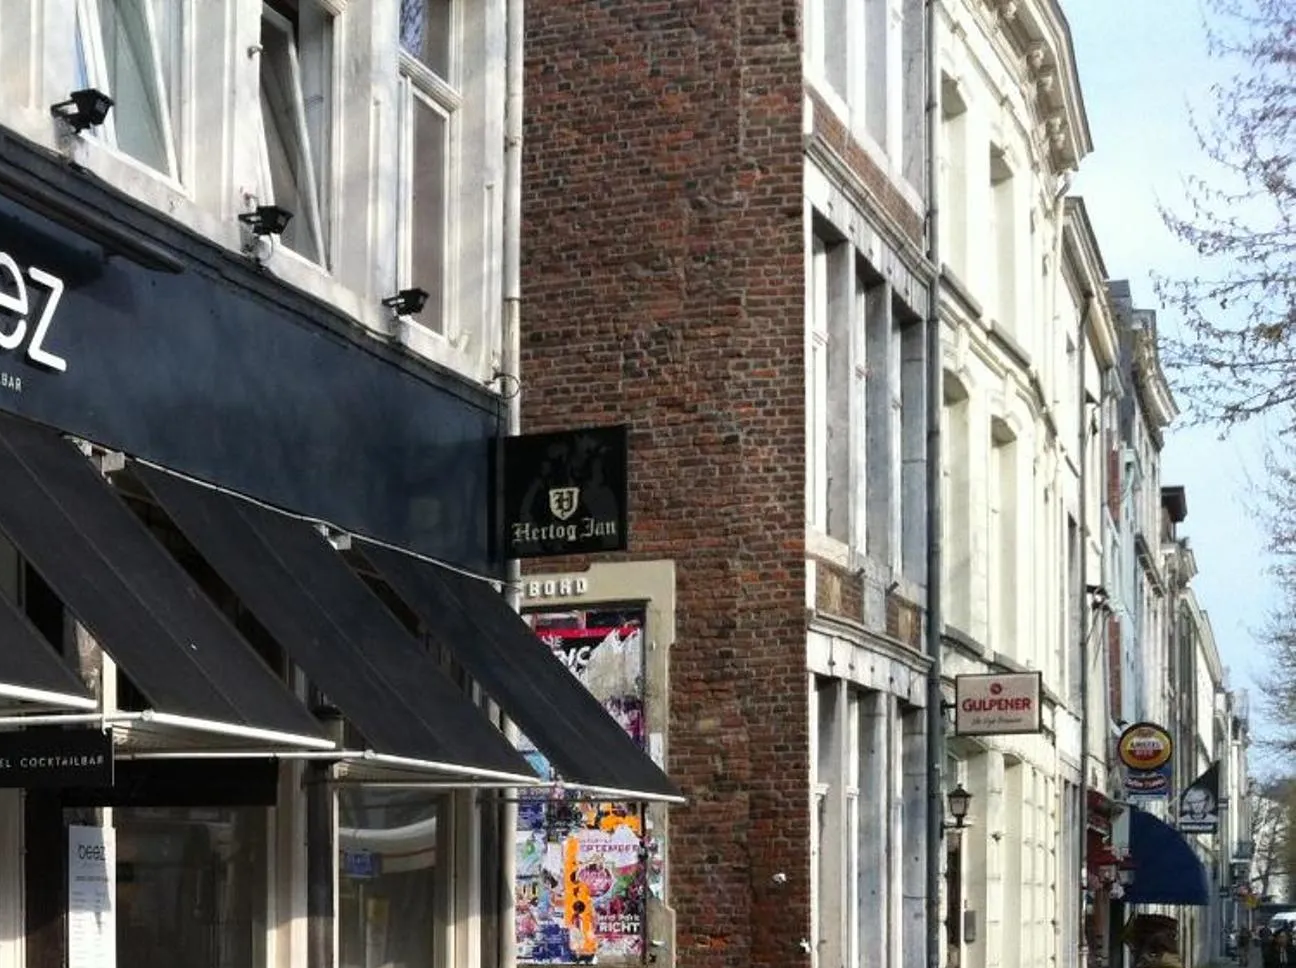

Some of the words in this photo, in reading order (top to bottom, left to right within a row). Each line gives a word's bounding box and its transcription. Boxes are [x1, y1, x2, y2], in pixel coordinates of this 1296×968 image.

[511, 522, 577, 543] Hertog
[580, 518, 617, 538] Jan
[520, 577, 588, 597] BORD
[962, 697, 1032, 713] GULPENER
[20, 755, 104, 768] COCKTAILBAR
[77, 843, 106, 861] beez
